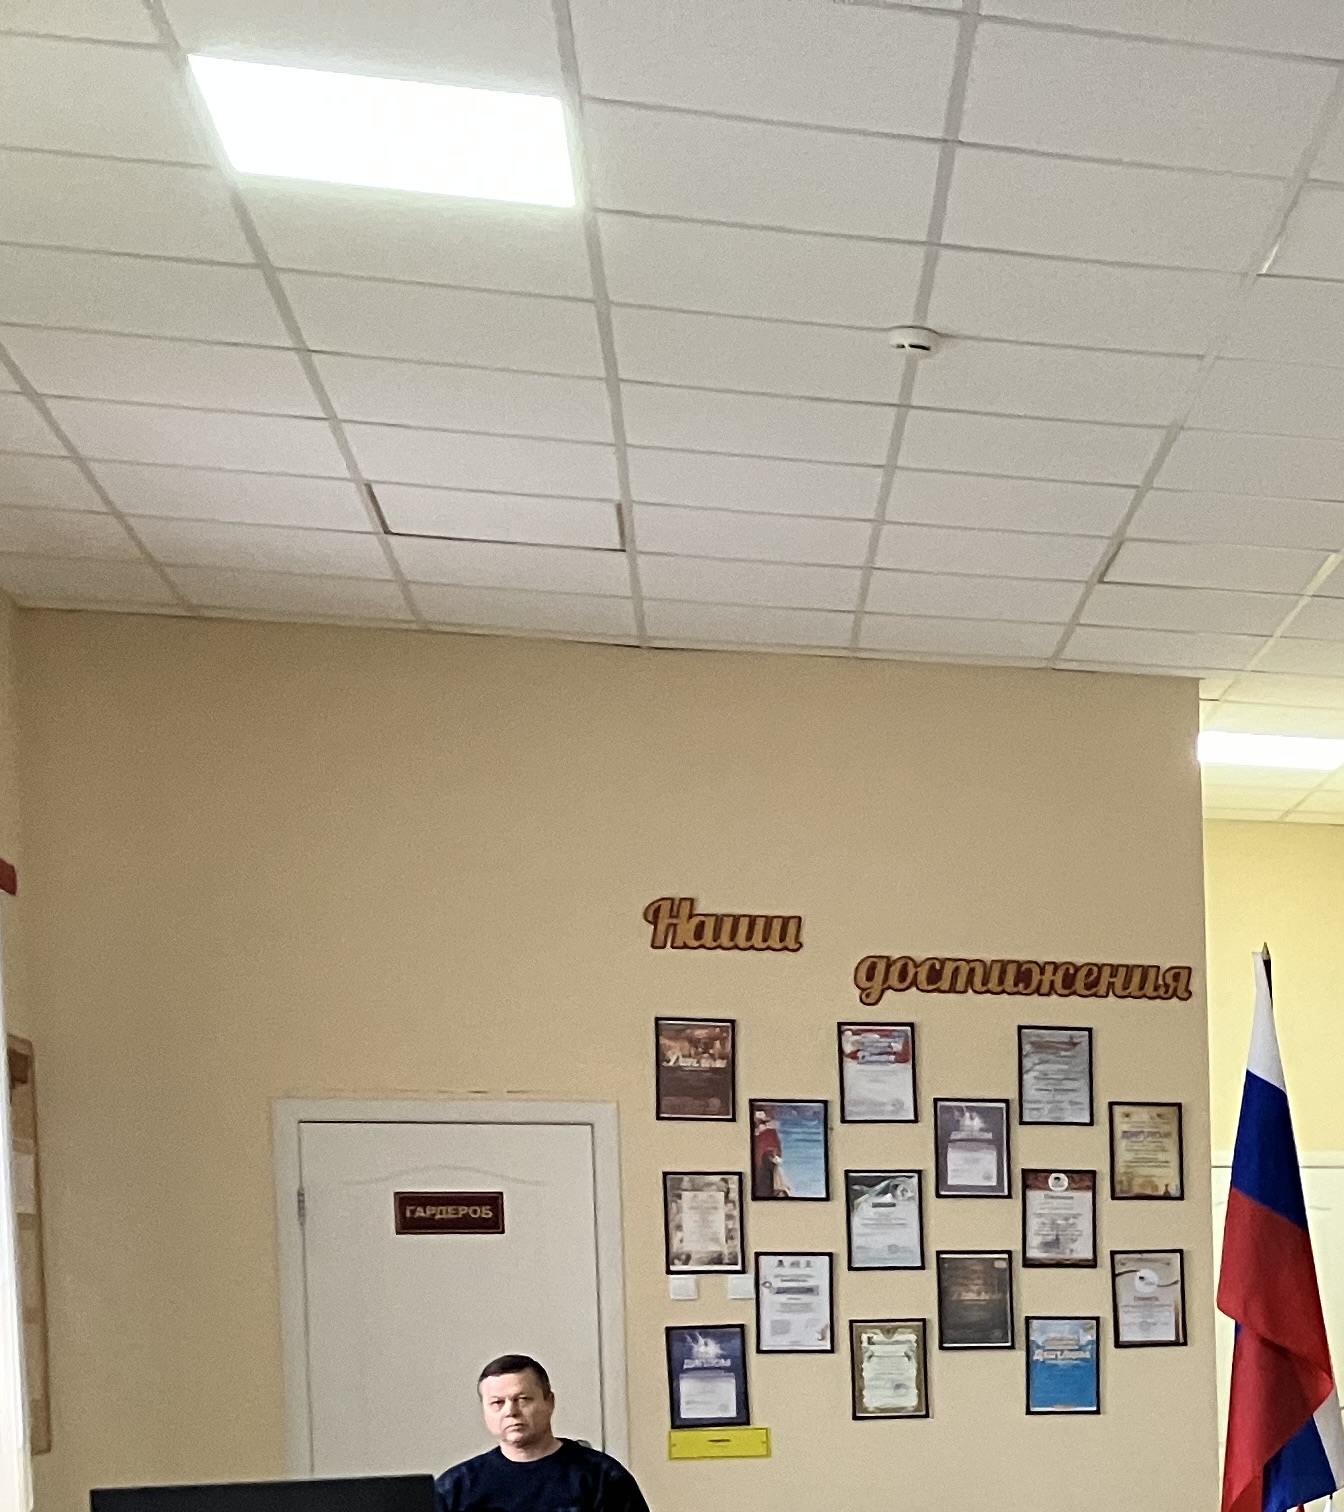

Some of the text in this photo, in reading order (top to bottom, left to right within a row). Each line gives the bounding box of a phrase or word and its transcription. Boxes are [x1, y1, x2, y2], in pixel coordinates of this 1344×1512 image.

[643, 897, 804, 952] Наши
[853, 955, 1193, 1006] достижения
[405, 1205, 494, 1220] ГАРДЕРОБ
